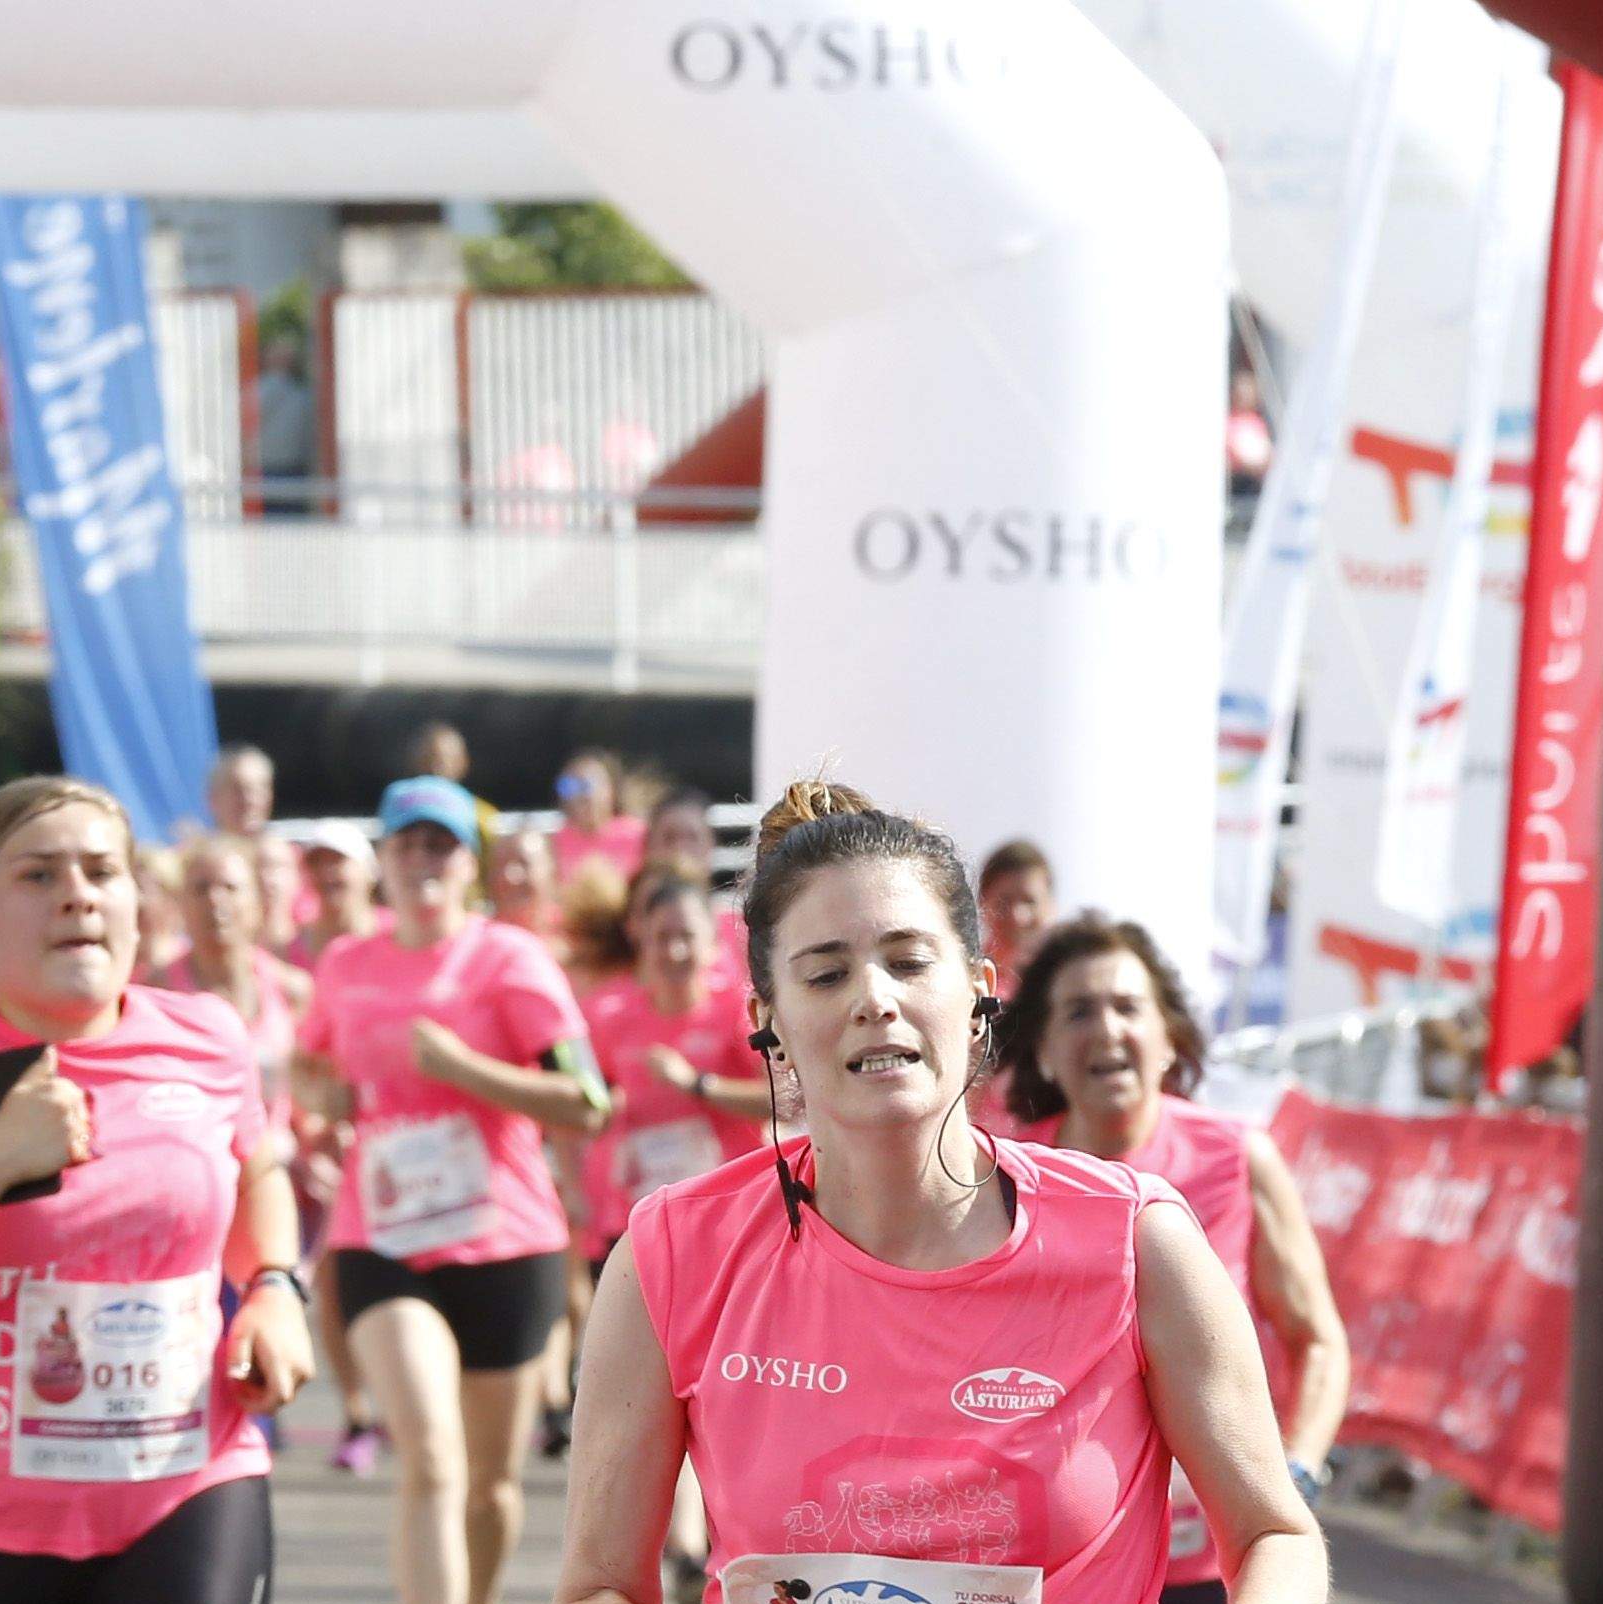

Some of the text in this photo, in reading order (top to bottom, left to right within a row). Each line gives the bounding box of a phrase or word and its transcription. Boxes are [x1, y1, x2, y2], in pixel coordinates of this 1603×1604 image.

[92, 1361, 160, 1391] 016
[720, 1353, 848, 1394] OYSHO
[959, 1384, 1056, 1409] ASTURIANA
[954, 1590, 970, 1601] TU
